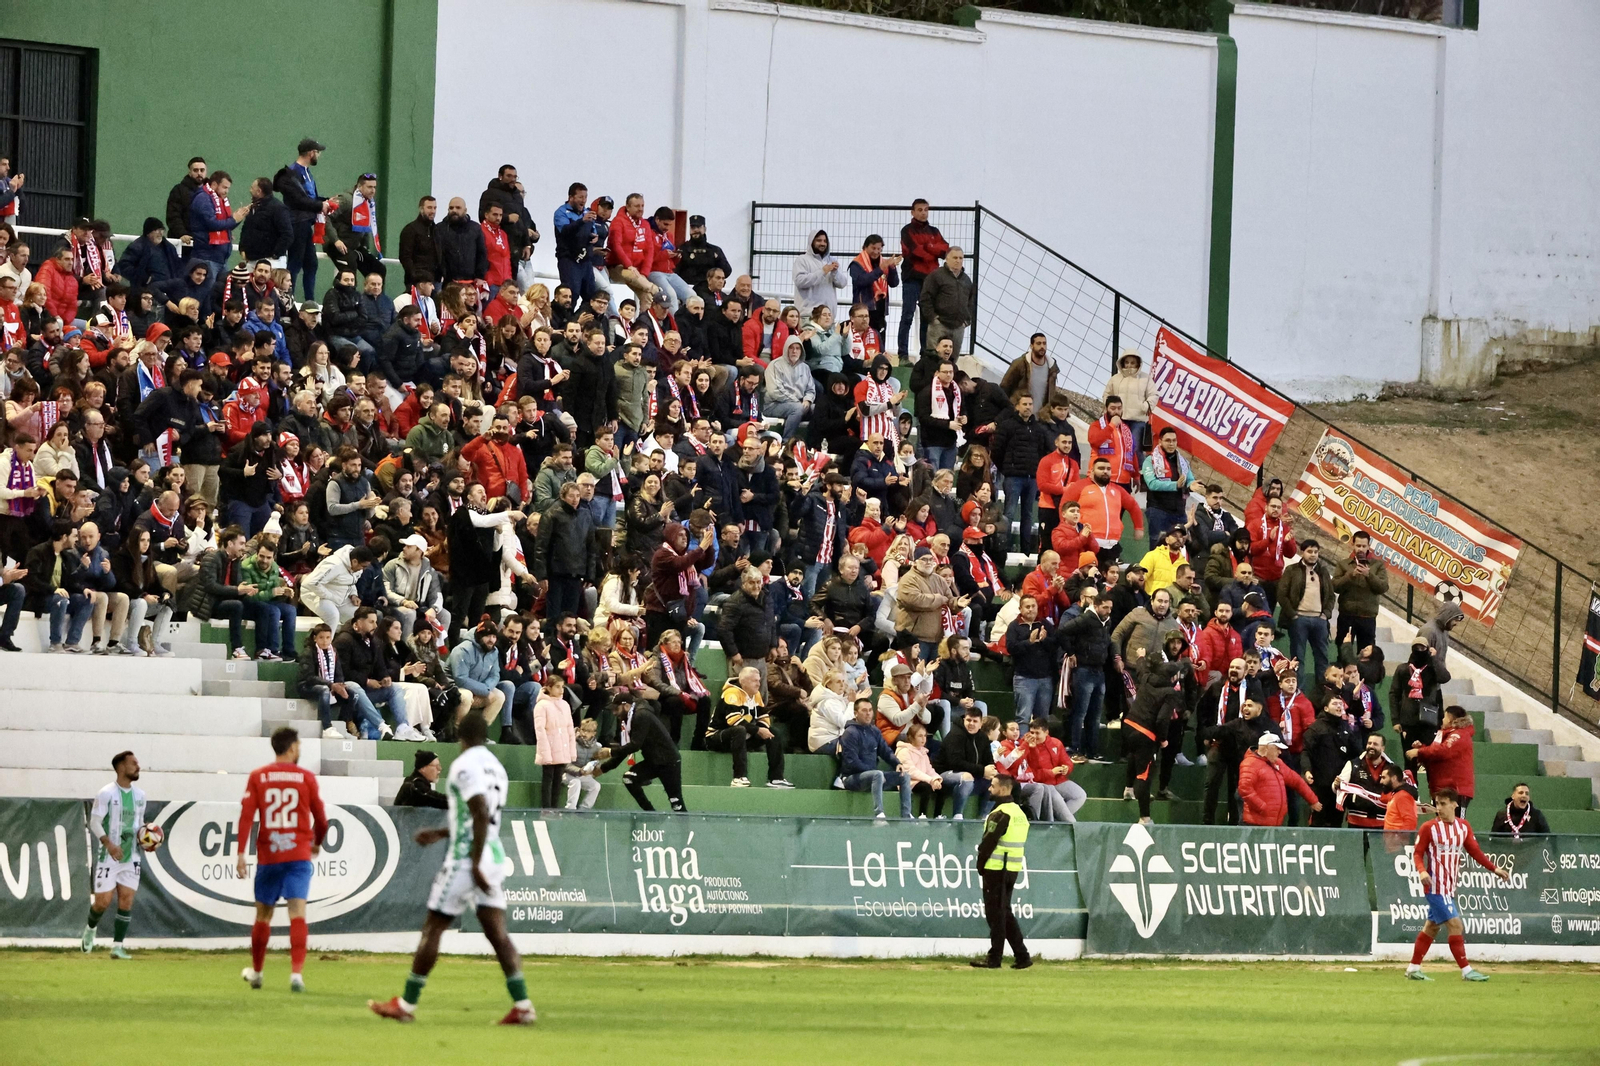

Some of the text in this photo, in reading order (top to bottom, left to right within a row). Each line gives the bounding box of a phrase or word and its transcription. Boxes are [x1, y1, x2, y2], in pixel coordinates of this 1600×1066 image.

[1403, 482, 1440, 517] PEÑA
[1352, 472, 1487, 563] LOS EXCURSIONISTAS
[265, 787, 299, 829] 22
[632, 823, 665, 842] sabor
[846, 839, 1029, 890] La Fábria
[1181, 842, 1337, 876] SCIENTIFFIC
[1560, 853, 1578, 869] 952
[704, 876, 742, 888] PRODUCTOS
[540, 887, 587, 902] Provincial
[706, 888, 749, 901] AUTÓCTONOS
[1458, 894, 1492, 915] para
[1493, 892, 1509, 911] tu
[512, 906, 564, 924] de Málaga
[708, 904, 763, 915] DE LA PROVINCIA
[853, 896, 918, 918] Escuela
[922, 897, 944, 918] de
[1462, 912, 1522, 935] vivienda
